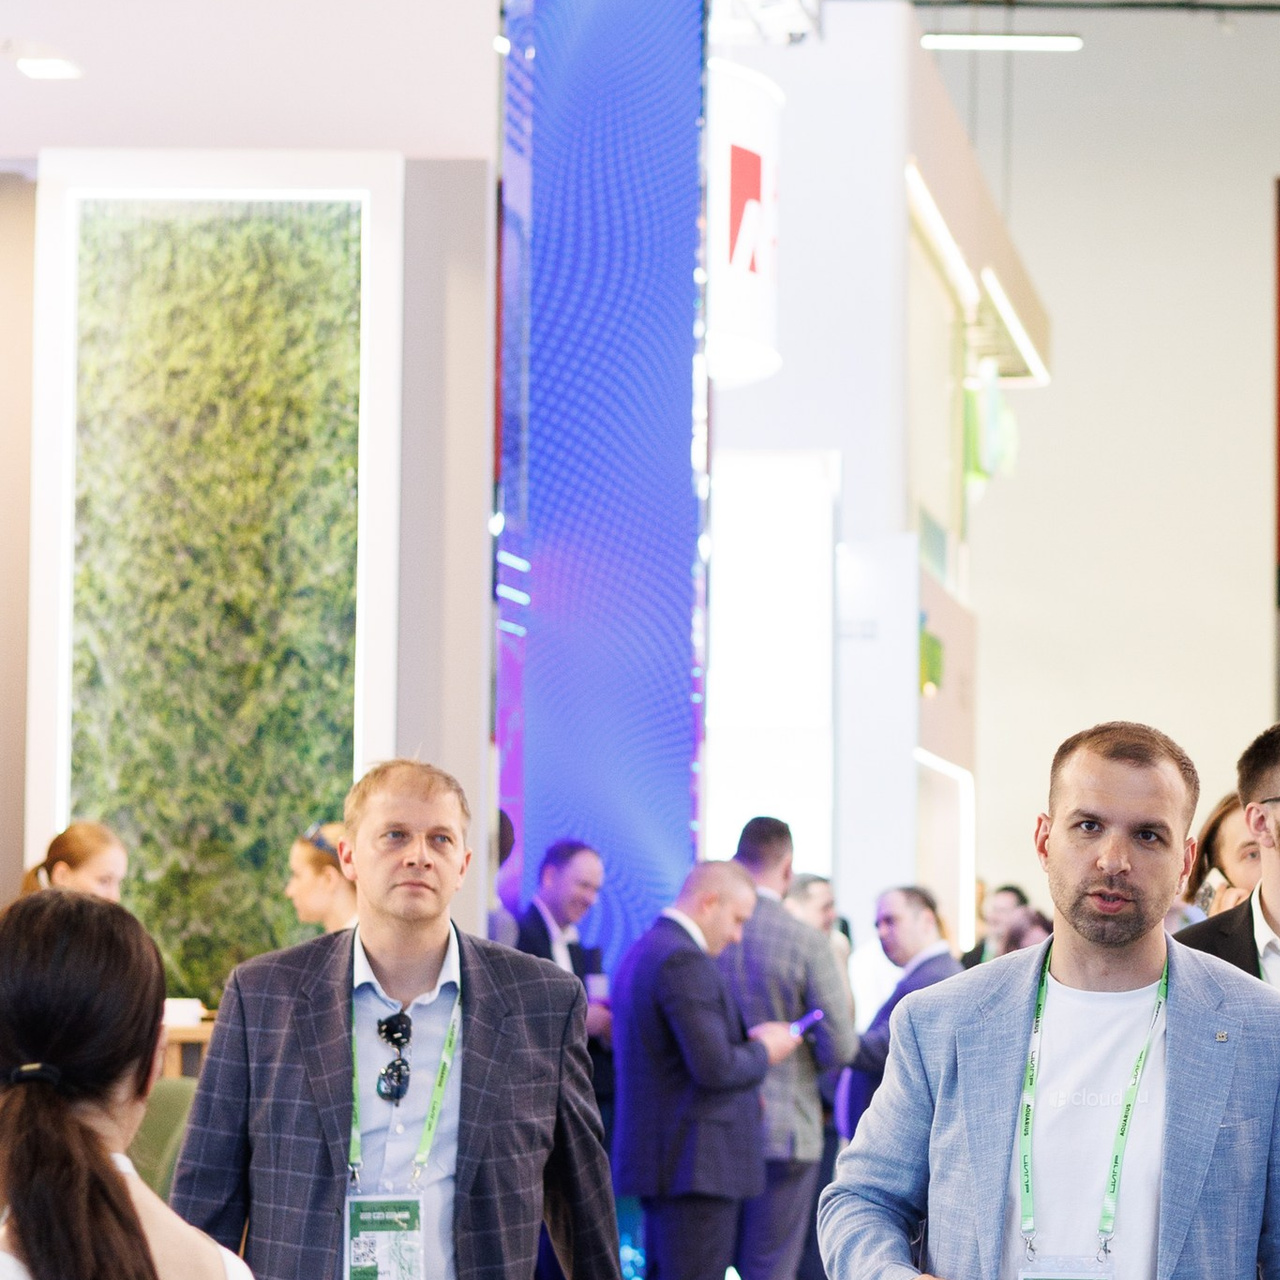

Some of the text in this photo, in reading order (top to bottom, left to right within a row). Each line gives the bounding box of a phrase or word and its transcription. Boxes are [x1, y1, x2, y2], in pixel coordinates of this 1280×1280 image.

[1071, 1088, 1149, 1107] cloudu
[1023, 1104, 1031, 1136] AQUARIUS
[1120, 1103, 1131, 1136] AQUARIUS
